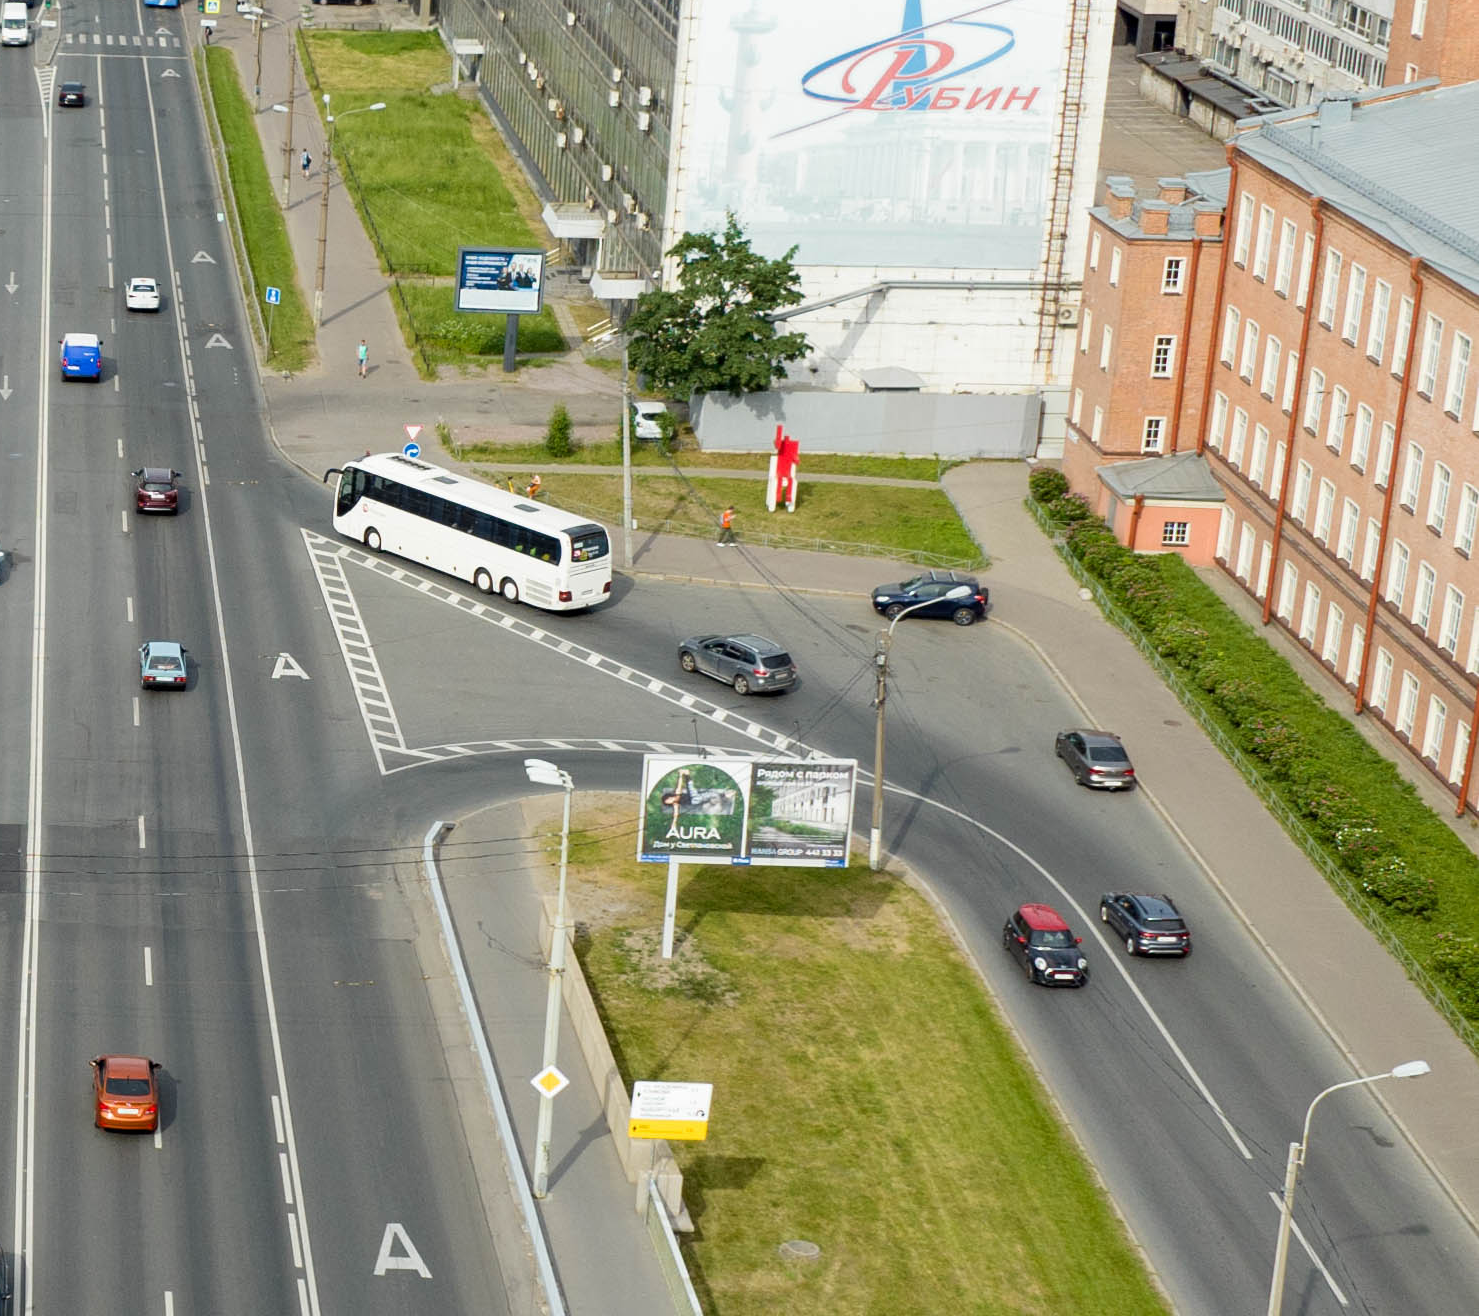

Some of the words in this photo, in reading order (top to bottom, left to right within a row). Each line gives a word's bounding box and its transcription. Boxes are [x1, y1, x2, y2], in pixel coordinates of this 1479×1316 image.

[842, 39, 1041, 111] РУБИН
[271, 652, 310, 680] А
[757, 768, 795, 779] Рядом
[795, 771, 804, 779] с
[804, 771, 850, 781] парком
[665, 826, 722, 840] AURA
[777, 848, 804, 856] GROUP
[373, 1223, 433, 1279] А
